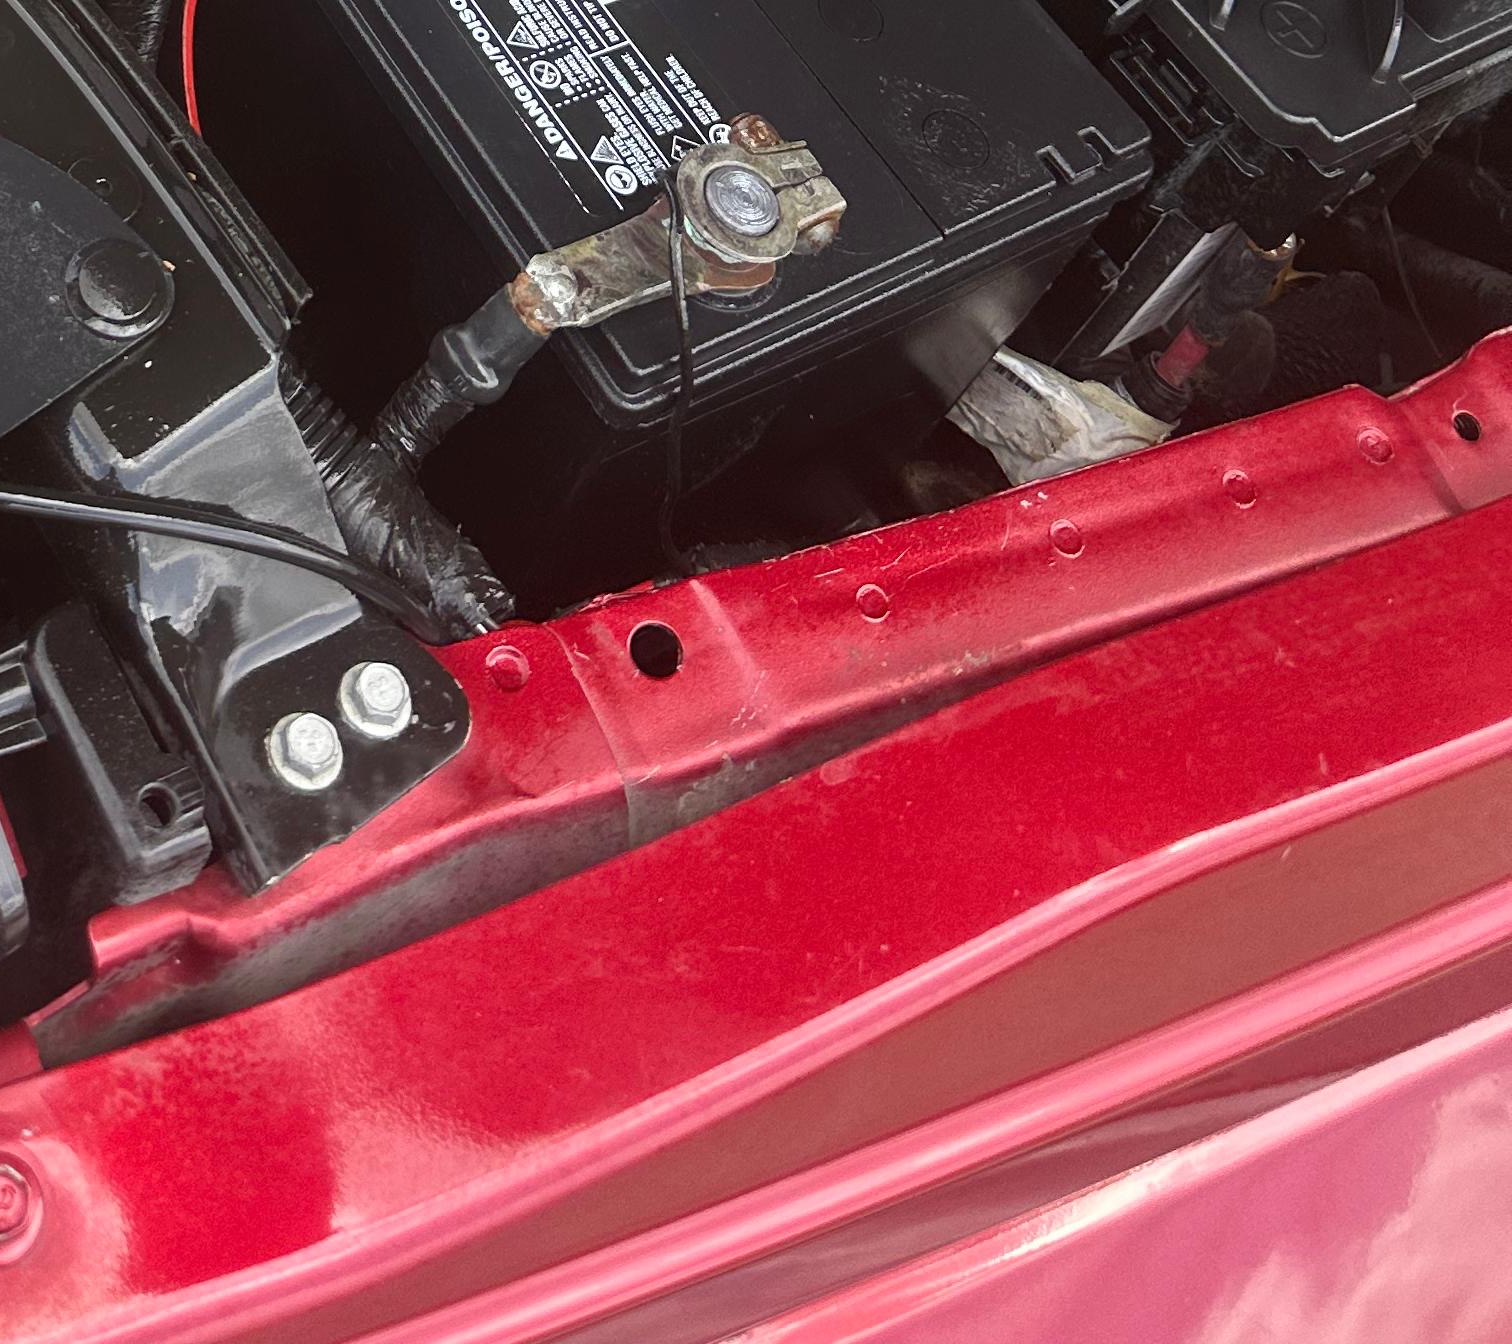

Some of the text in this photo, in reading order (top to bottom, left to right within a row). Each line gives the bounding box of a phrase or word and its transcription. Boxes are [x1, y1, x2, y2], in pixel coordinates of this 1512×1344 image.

[535, 1, 561, 29] SEVERE
[581, 0, 599, 13] TIP
[536, 18, 561, 43] CAUSE
[554, 27, 569, 39] OR
[591, 12, 611, 30] NOT
[576, 27, 599, 50] READ
[603, 28, 621, 43] DO
[552, 56, 581, 86] SPARKS
[561, 52, 590, 83] FLAMES
[632, 68, 652, 87] HELP
[629, 94, 650, 114] EYES
[662, 68, 712, 125] KEEP OUT OF THE
[689, 86, 704, 98] OF
[696, 96, 721, 121] REACH
[603, 110, 631, 139] GASES
[642, 111, 667, 136] FLUSH
[654, 112, 675, 132] WITH
[624, 155, 654, 186] SHIELD
